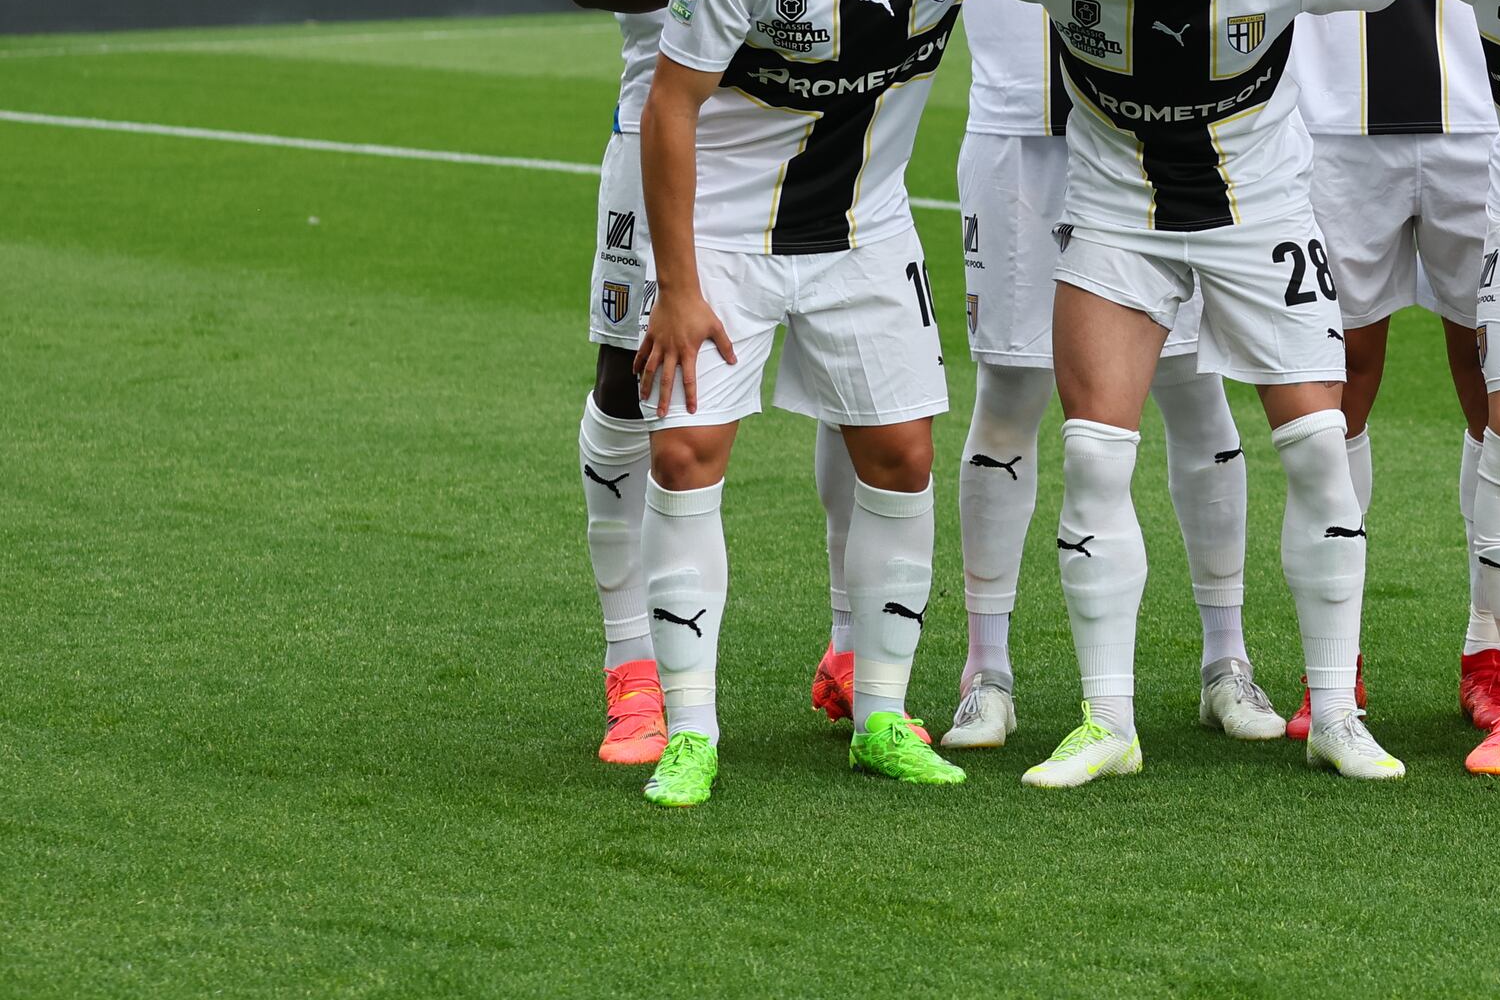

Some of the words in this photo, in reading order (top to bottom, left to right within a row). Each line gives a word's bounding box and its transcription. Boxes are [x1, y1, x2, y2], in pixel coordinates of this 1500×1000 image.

[757, 22, 829, 42] FOOTBALL
[773, 20, 812, 32] CLASSIC
[774, 38, 812, 52] SHIRTS
[748, 31, 948, 99] PROMETEON
[616, 255, 641, 267] POOL
[1271, 238, 1338, 307] 28
